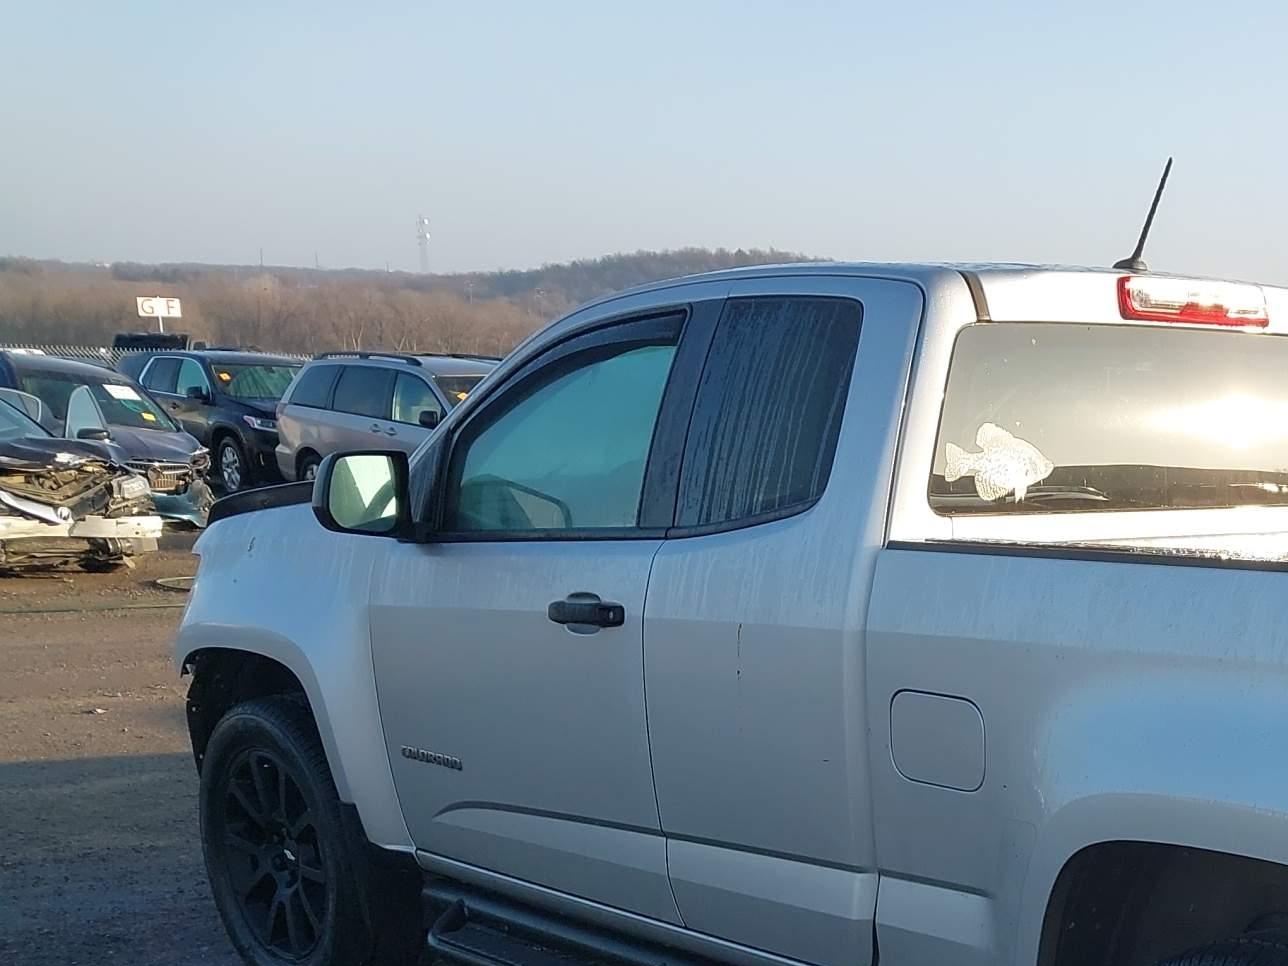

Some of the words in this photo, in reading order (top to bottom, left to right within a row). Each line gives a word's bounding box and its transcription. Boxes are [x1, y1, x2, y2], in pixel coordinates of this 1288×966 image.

[141, 298, 155, 315] G
[166, 299, 176, 315] F
[400, 744, 463, 771] COLORADO
